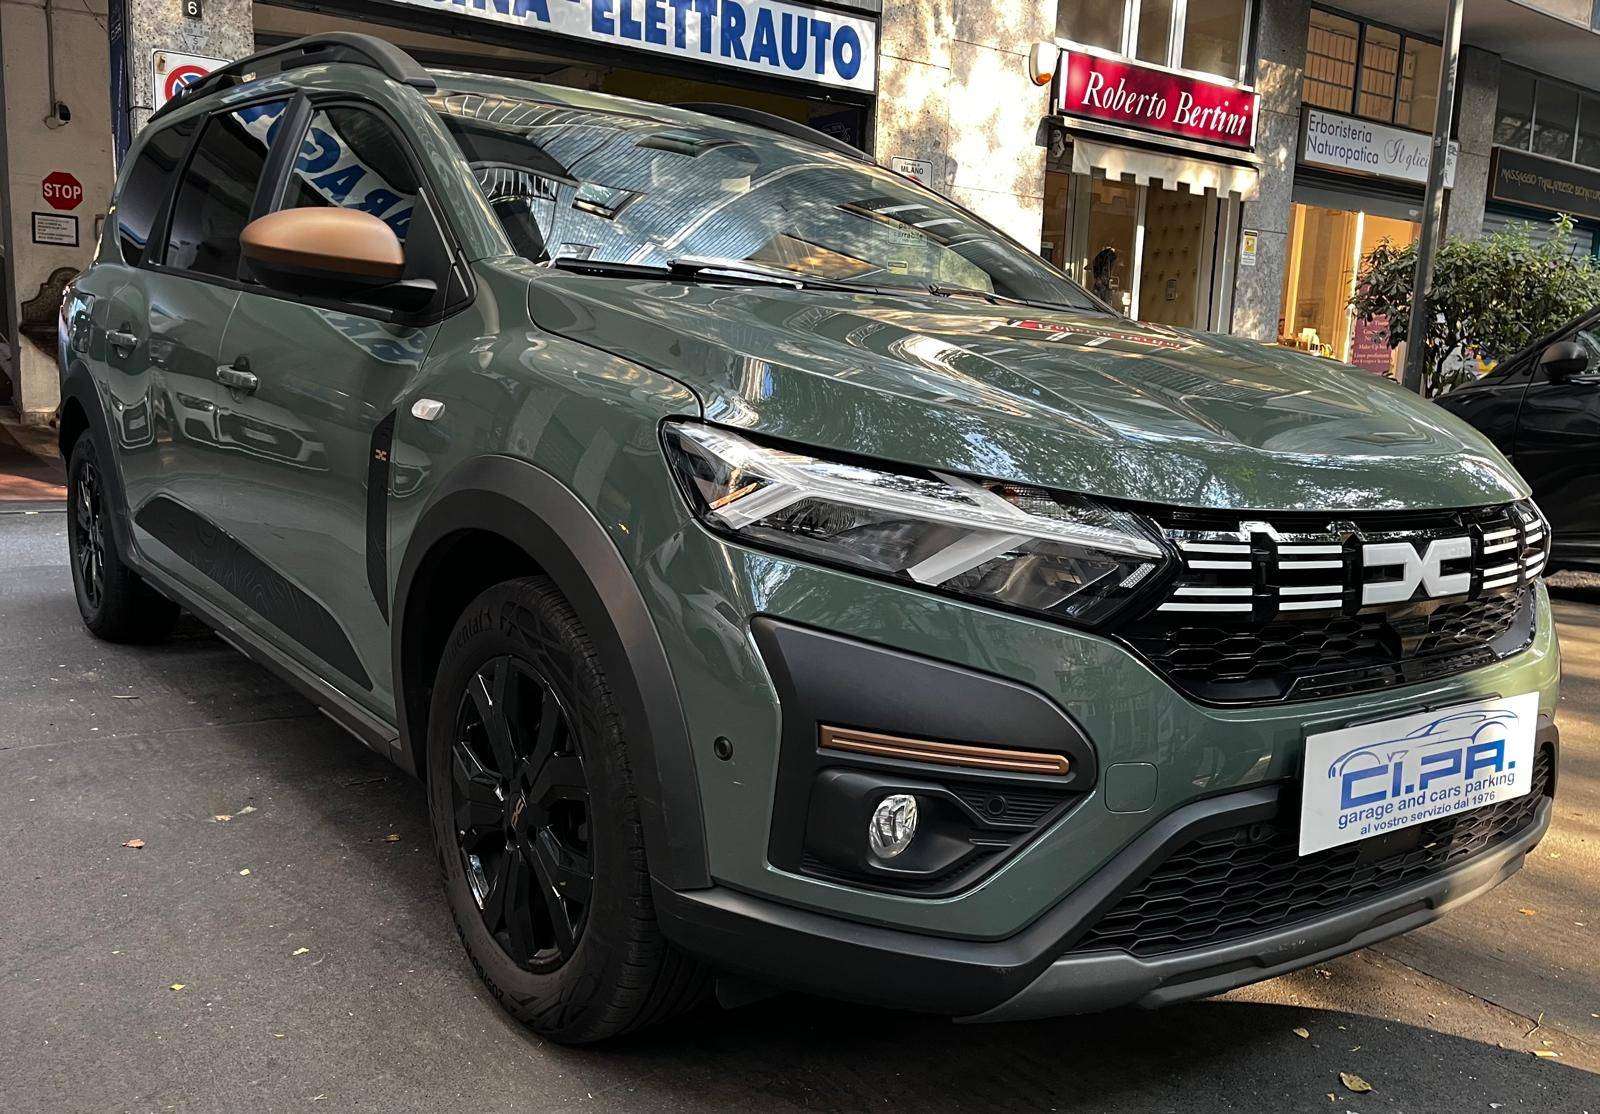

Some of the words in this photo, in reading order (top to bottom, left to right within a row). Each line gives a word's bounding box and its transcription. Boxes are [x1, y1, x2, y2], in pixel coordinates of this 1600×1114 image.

[187, 1, 197, 15] 6
[591, 0, 862, 81] ELETTRAUTO
[1081, 71, 1167, 121] Roberto
[1172, 91, 1250, 137] Bertini
[1308, 114, 1372, 143] Erboristeria
[1306, 135, 1379, 164] Naturopatica
[1405, 146, 1430, 171] glici
[900, 165, 924, 175] MILANO
[43, 182, 82, 199] STOP
[1338, 800, 1394, 830] garage
[1399, 792, 1426, 813] and
[1430, 786, 1461, 802] cars
[1465, 772, 1515, 798] parking
[1360, 823, 1371, 835] al
[1373, 815, 1408, 833] vostro
[1410, 803, 1451, 822] servizio
[1453, 798, 1469, 810] dal
[1472, 791, 1496, 806] 1976
